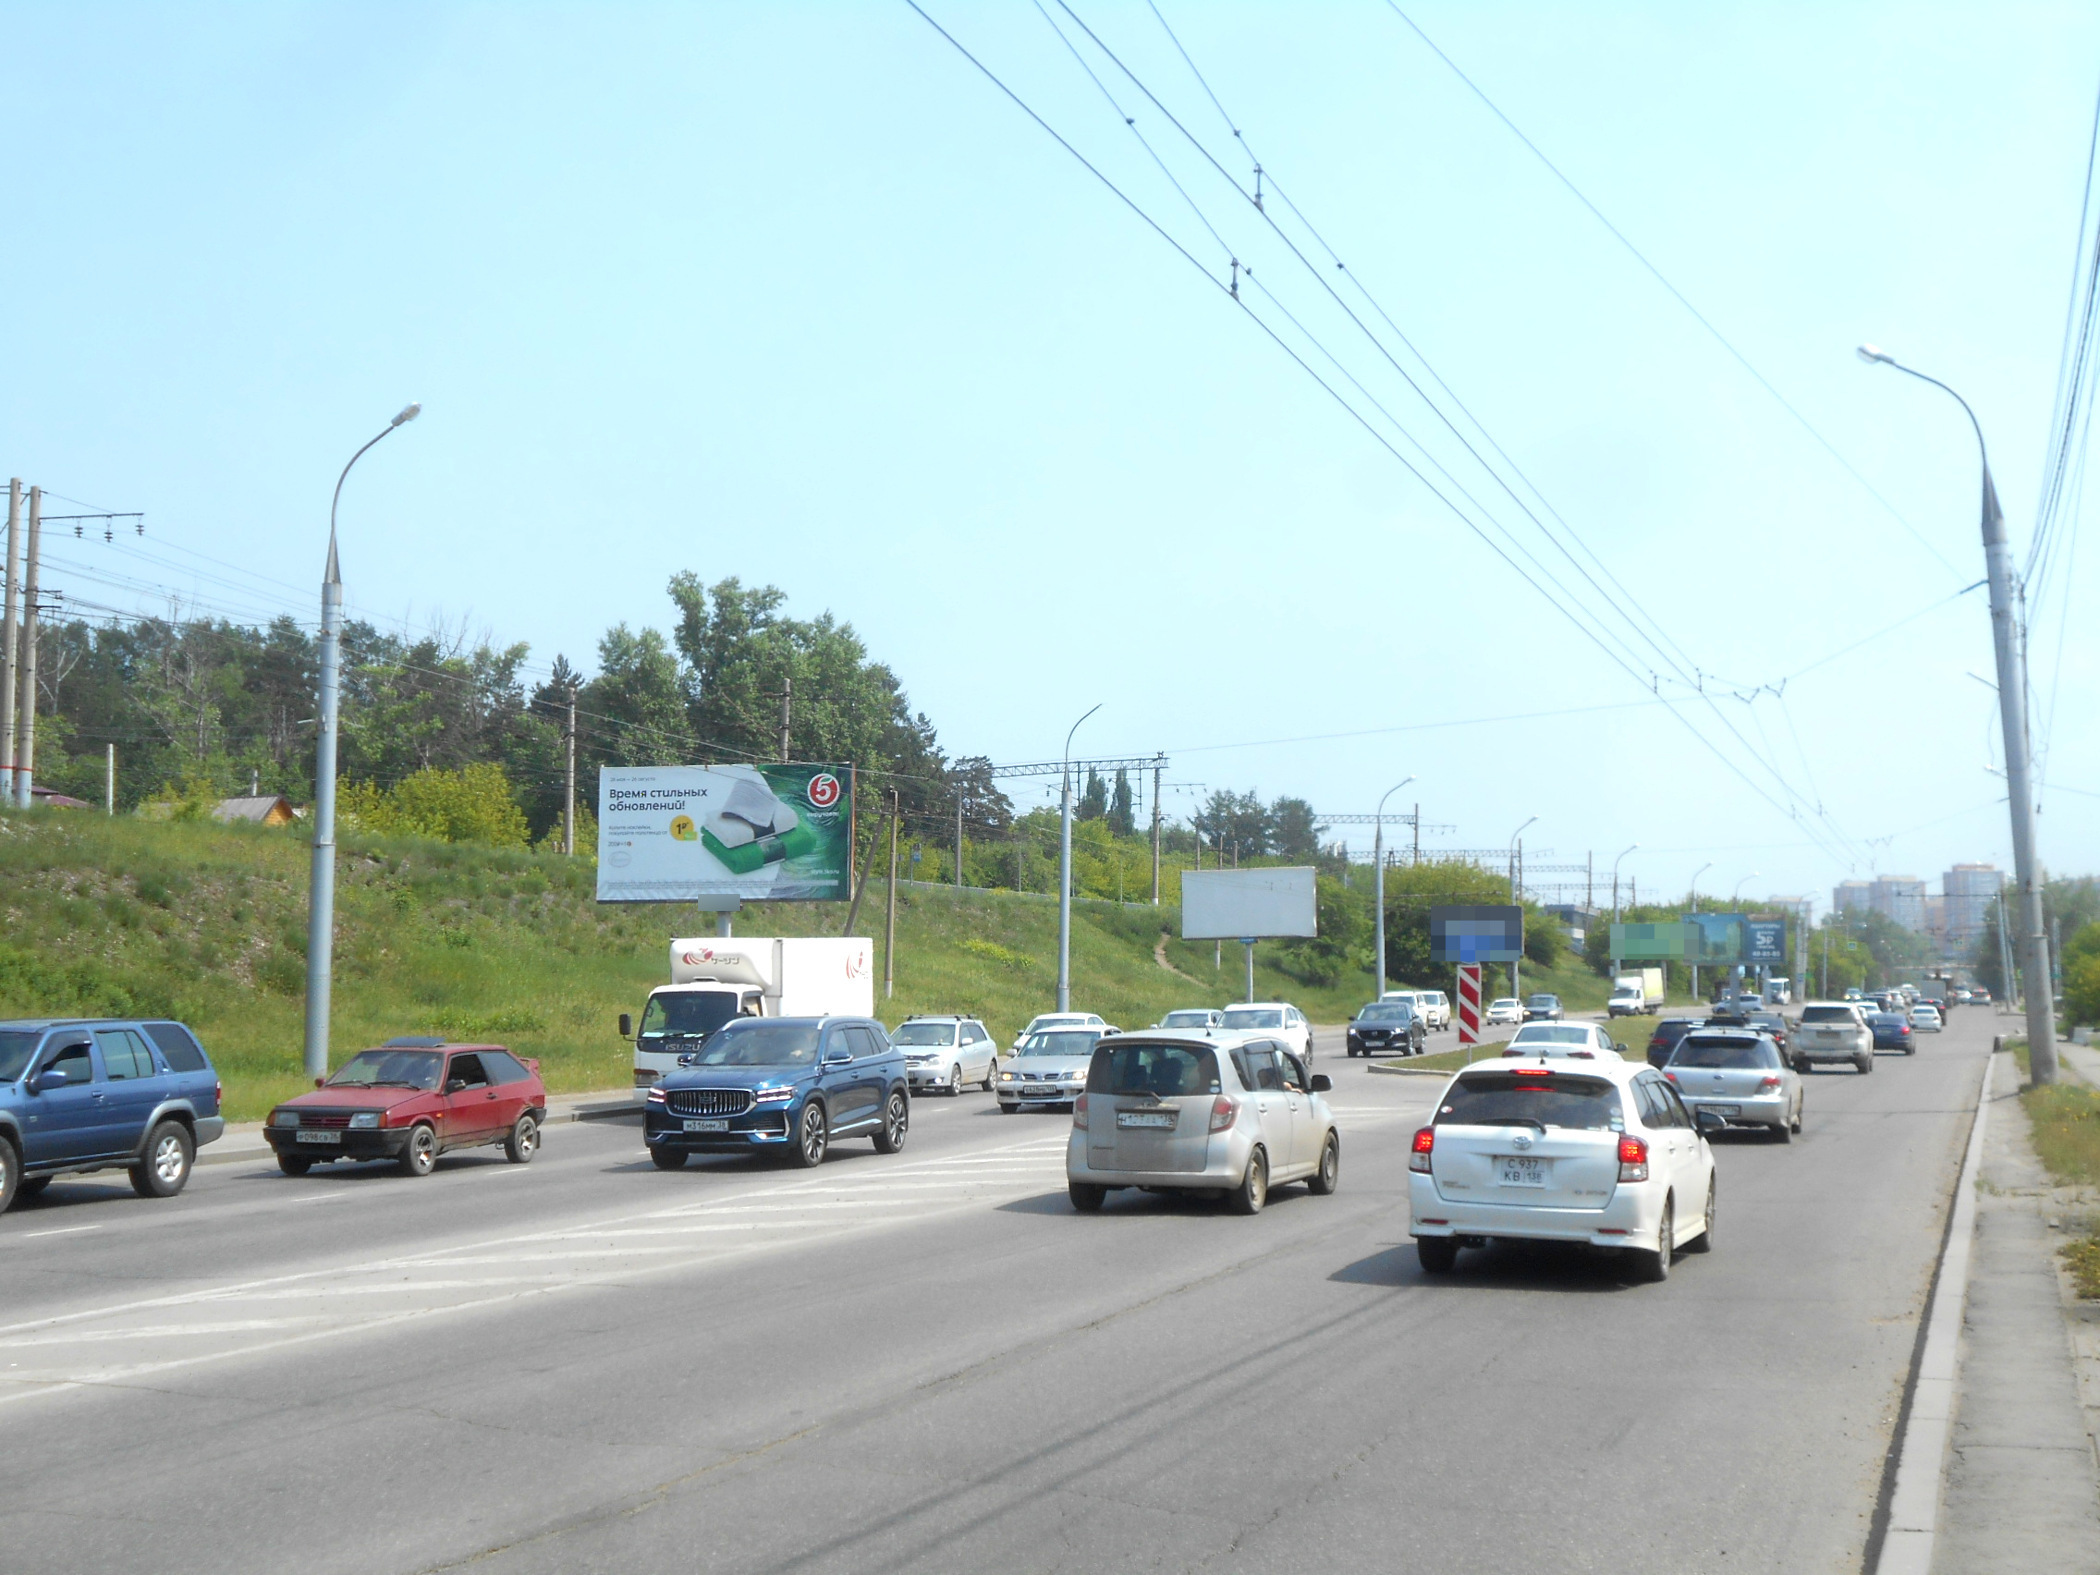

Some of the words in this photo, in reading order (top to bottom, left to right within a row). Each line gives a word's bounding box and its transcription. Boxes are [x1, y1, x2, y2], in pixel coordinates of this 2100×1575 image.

[609, 789, 647, 800] Время
[650, 788, 708, 798] стильных
[609, 800, 686, 811] обновлений!
[665, 1043, 701, 1051] ISUZU
[1519, 1159, 1538, 1170] 937
